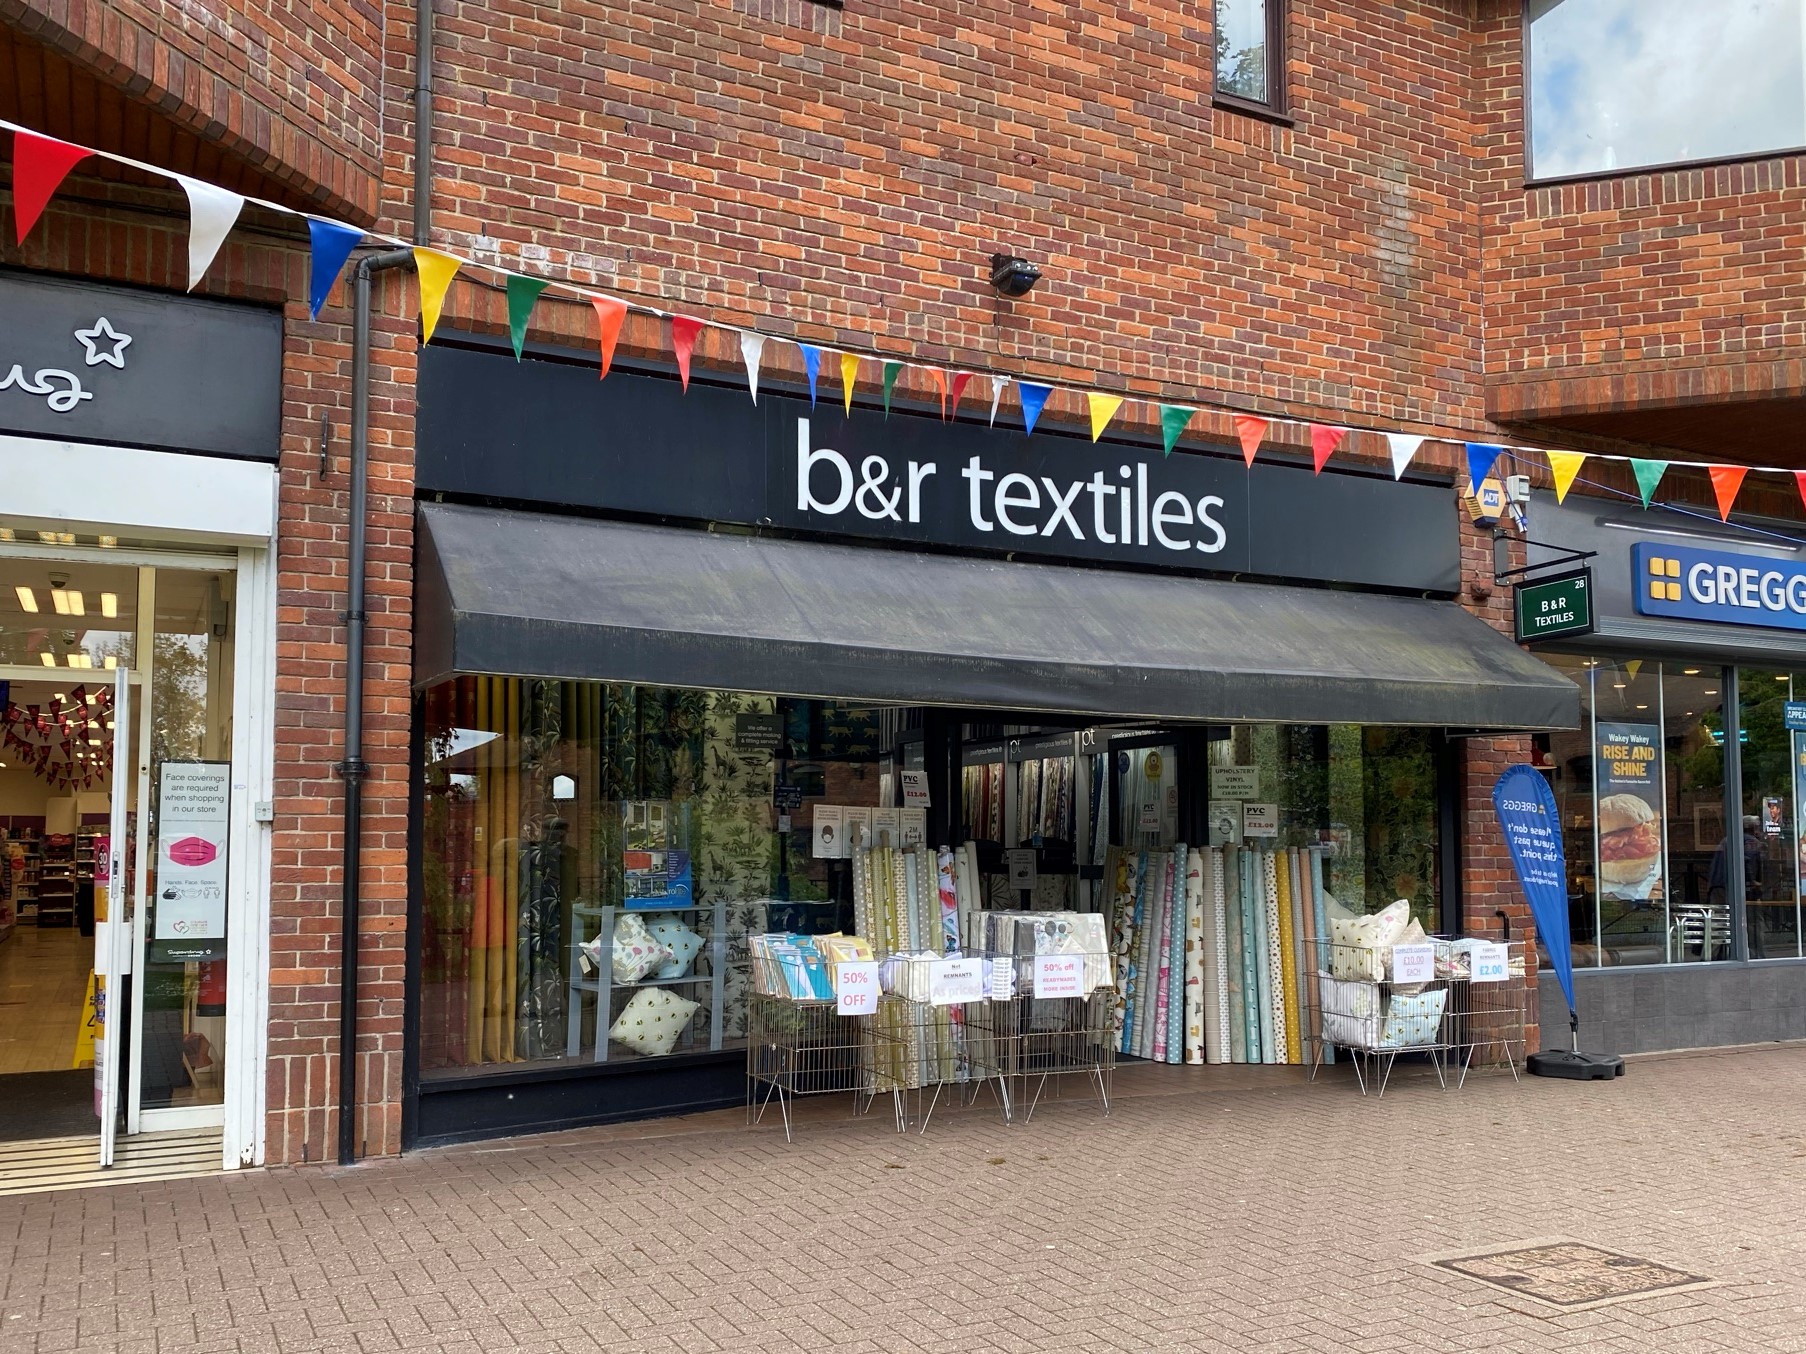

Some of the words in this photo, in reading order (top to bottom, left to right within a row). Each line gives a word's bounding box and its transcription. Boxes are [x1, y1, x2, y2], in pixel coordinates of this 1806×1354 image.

[797, 418, 936, 521] b&r
[961, 456, 1227, 553] textiles
[1483, 492, 1499, 503] ADT
[1575, 580, 1585, 589] 28
[1535, 612, 1574, 627] TEXTILES
[1609, 734, 1629, 744] Wakey
[1630, 735, 1649, 746] Wakey
[1603, 745, 1630, 759] RISE
[1632, 746, 1655, 761] AND
[1613, 762, 1647, 777] SHINE
[166, 773, 185, 781] Face
[188, 775, 225, 783] coverings
[187, 785, 219, 793] required
[189, 795, 225, 803] shopping
[1044, 963, 1063, 972] 50%
[1480, 965, 1503, 975] £2.00
[843, 972, 868, 984] 50%
[843, 995, 866, 1006] OFF
